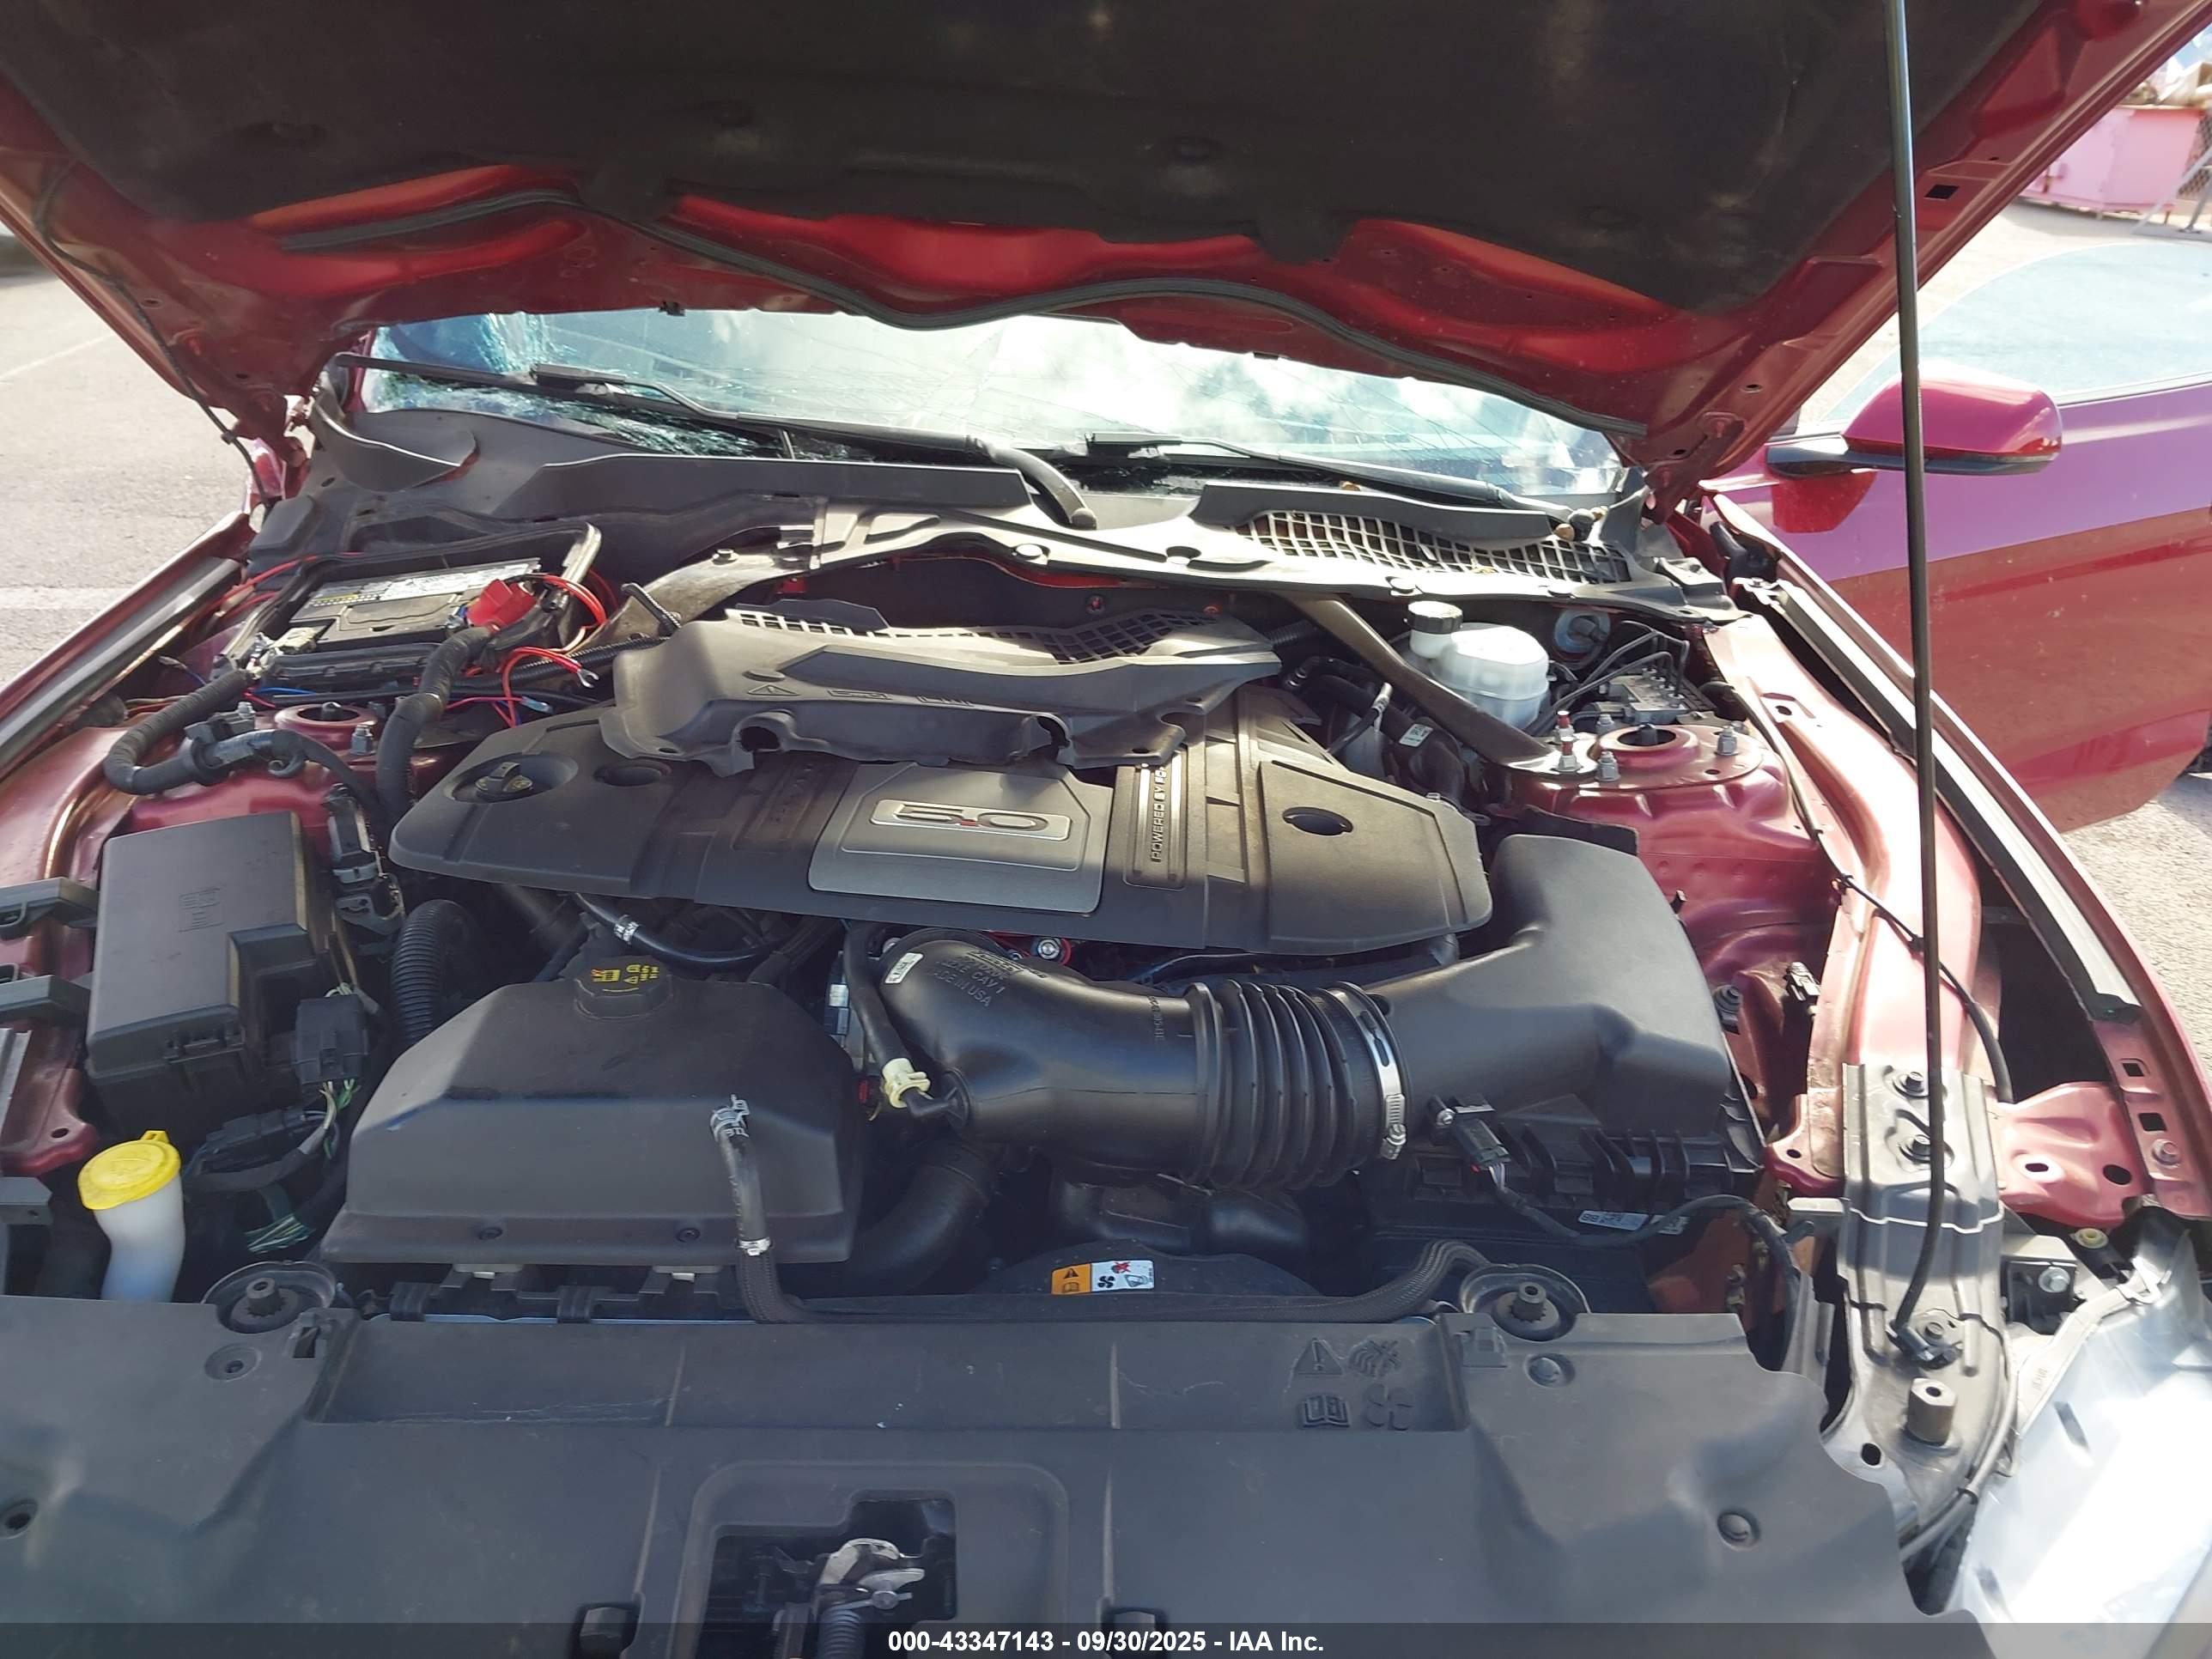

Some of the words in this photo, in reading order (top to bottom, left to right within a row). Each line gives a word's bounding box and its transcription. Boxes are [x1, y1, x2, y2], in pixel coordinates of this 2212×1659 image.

[1153, 787, 1165, 801] BY
[894, 803, 1049, 831] 5.0
[1151, 803, 1164, 862] POWERED
[968, 985, 992, 1007] USA
